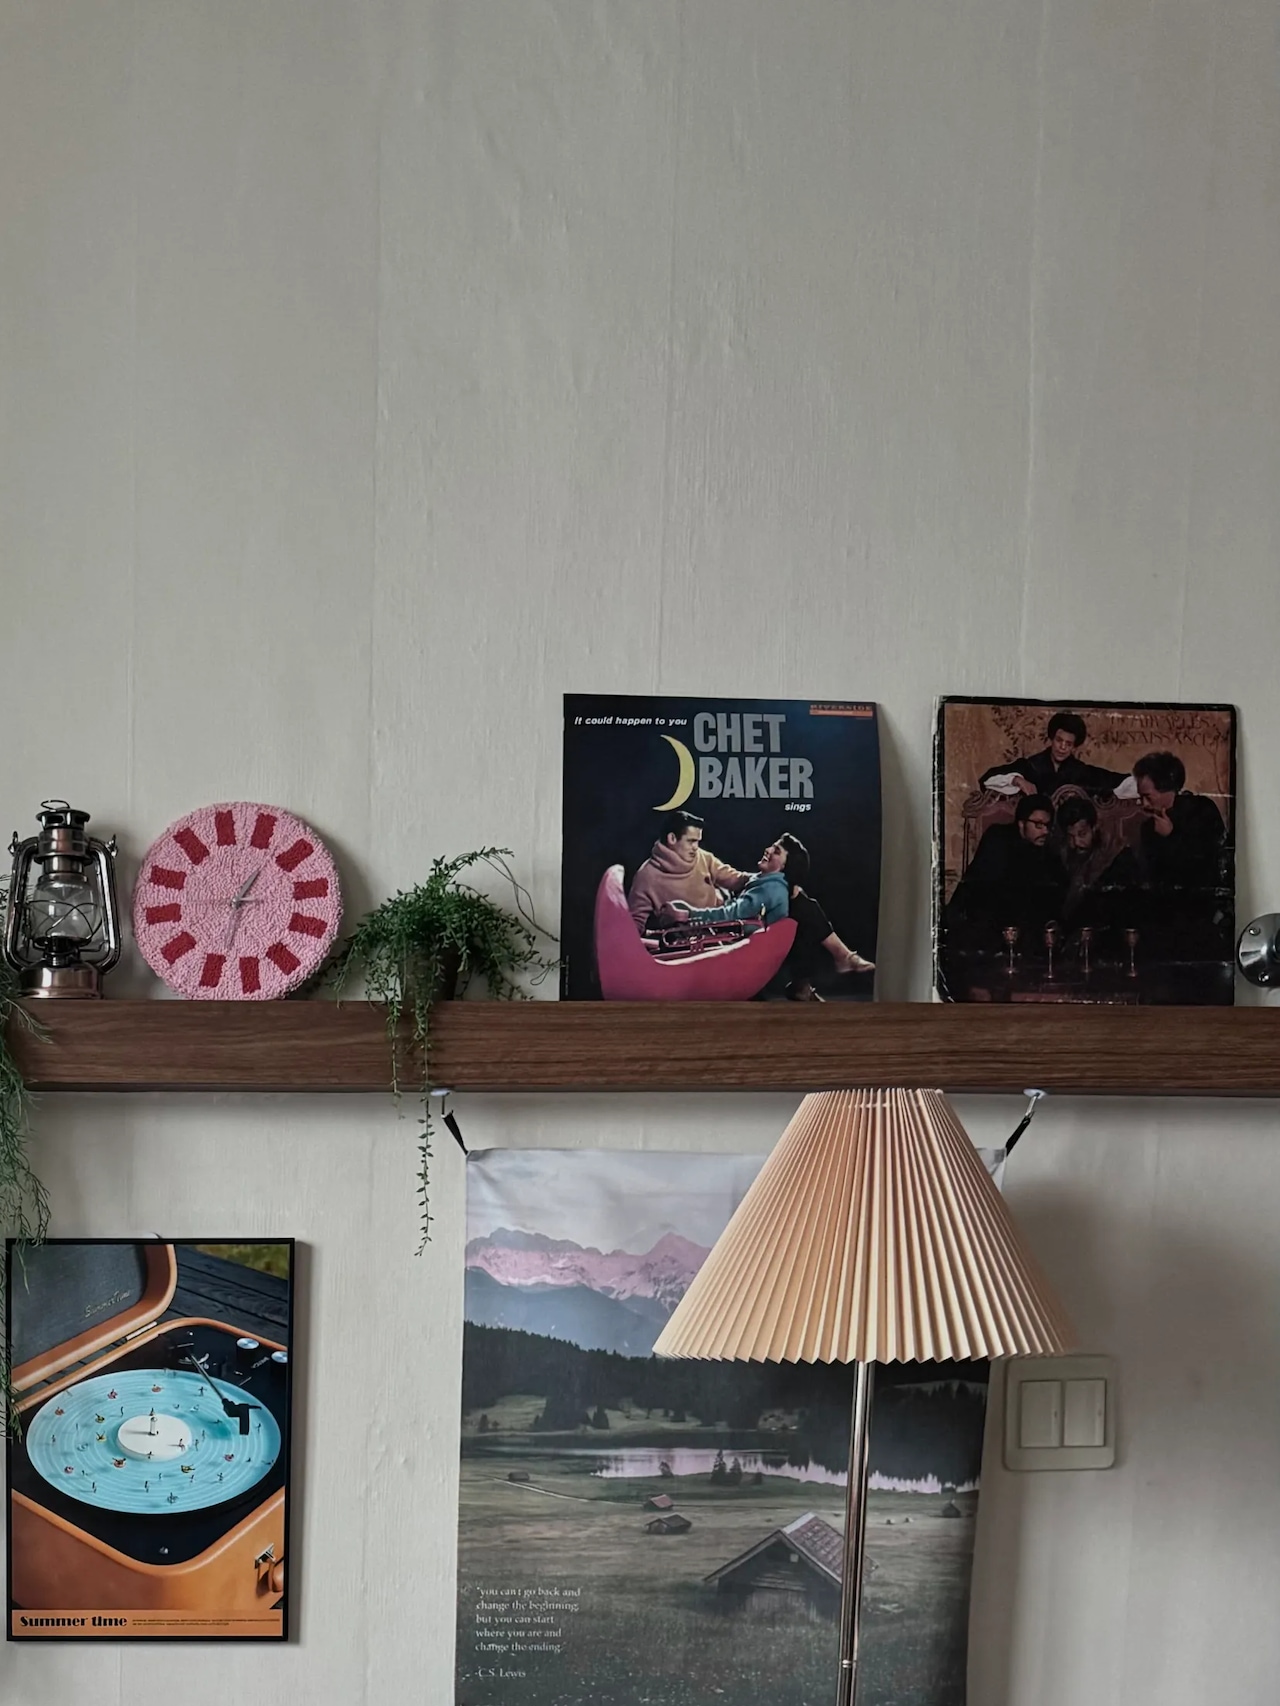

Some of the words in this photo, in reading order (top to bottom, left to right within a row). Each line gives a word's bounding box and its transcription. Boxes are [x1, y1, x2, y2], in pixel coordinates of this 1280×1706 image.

[574, 716, 582, 725] It
[585, 716, 613, 725] could
[615, 716, 652, 726] happen
[655, 717, 665, 725] to
[669, 718, 687, 726] you
[693, 711, 786, 753] CHET
[698, 756, 815, 799] BAKER
[784, 802, 812, 812] sings
[524, 1589, 535, 1598] go
[538, 1587, 560, 1596] back
[562, 1587, 581, 1597] and
[476, 1601, 510, 1612] change
[512, 1601, 527, 1610] the
[19, 1616, 88, 1627] Summer
[91, 1616, 127, 1627] time
[476, 1614, 491, 1624] but
[494, 1616, 513, 1626] you
[532, 1615, 554, 1624] start
[475, 1628, 505, 1637] where
[507, 1630, 525, 1640] you
[544, 1628, 561, 1637] and
[475, 1642, 509, 1653] change
[511, 1642, 527, 1651] the
[499, 1668, 526, 1677] Lewis
